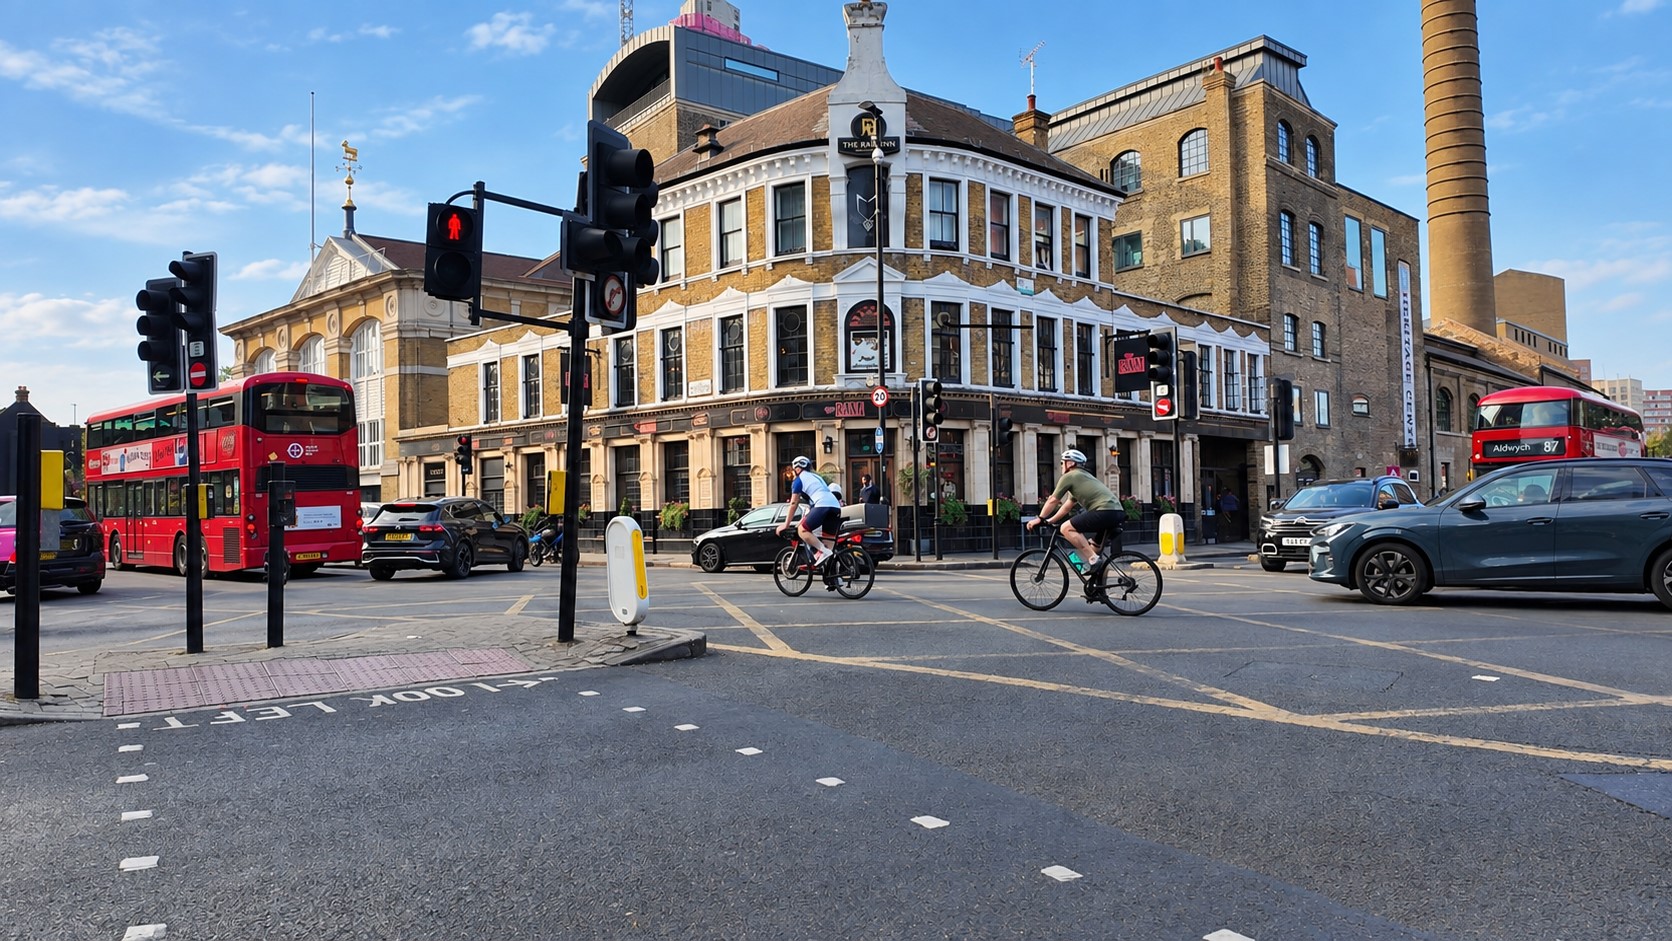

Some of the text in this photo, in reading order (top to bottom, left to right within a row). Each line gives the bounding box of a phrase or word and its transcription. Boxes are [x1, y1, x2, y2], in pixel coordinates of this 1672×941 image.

[874, 392, 886, 402] 20
[1493, 440, 1560, 454] Aldwych 87
[153, 682, 499, 731] LOOK LEFT
